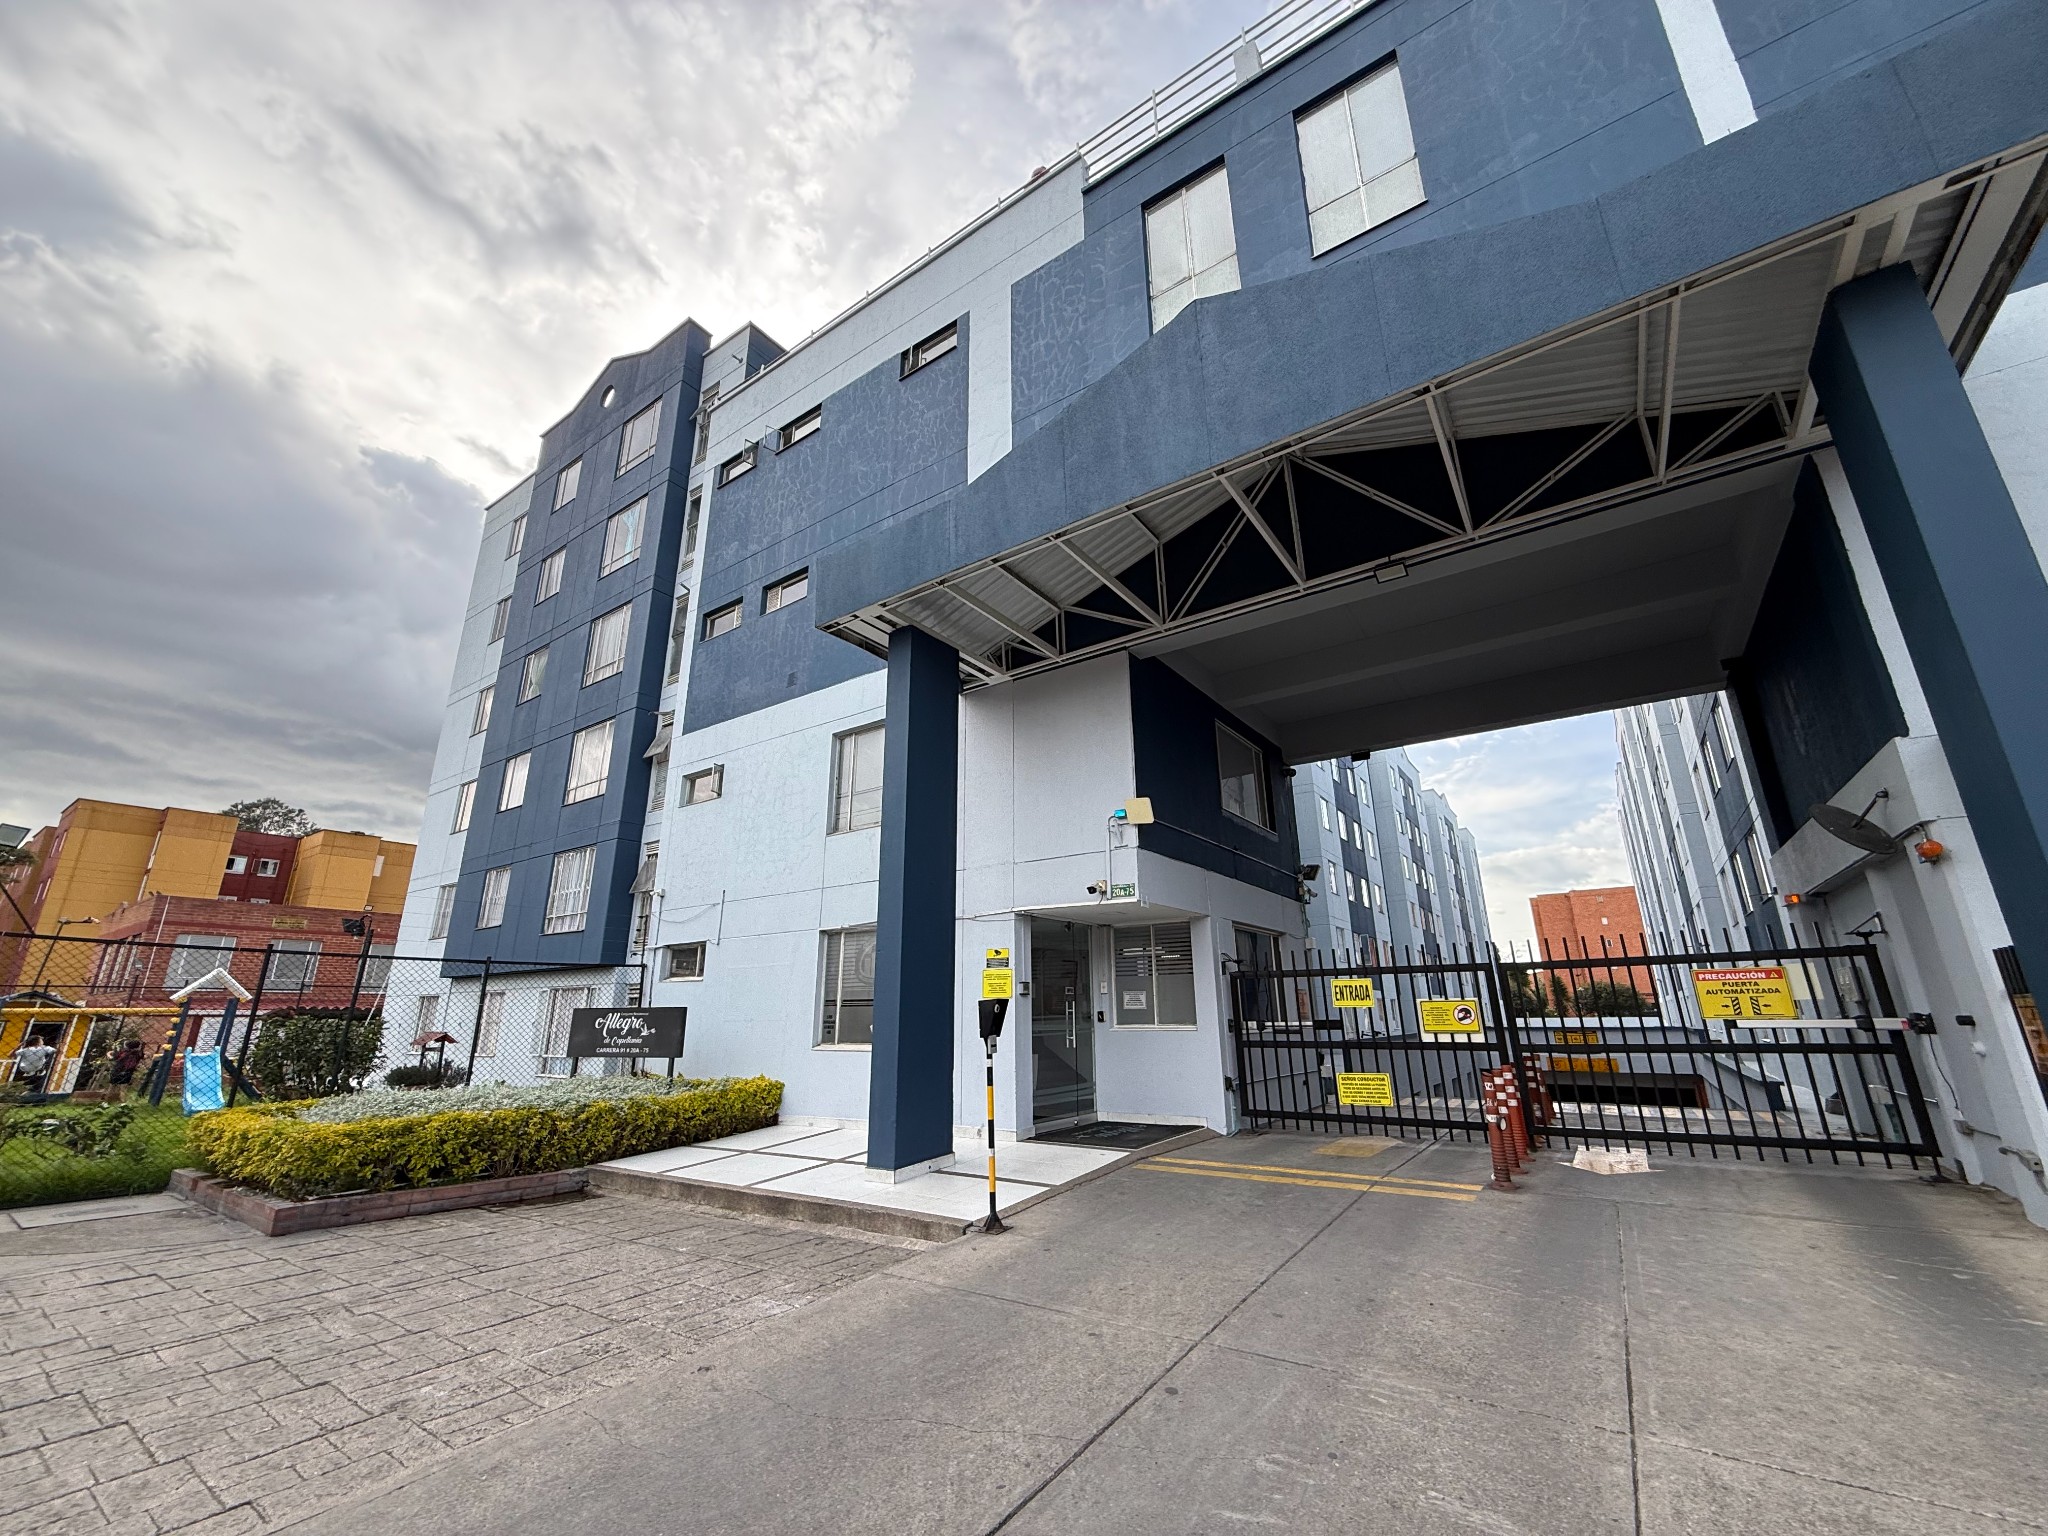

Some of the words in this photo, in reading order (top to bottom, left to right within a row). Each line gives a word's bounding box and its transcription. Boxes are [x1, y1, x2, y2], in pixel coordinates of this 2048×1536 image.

[1112, 887, 1134, 896] 20A-75
[1698, 971, 1766, 980] PRECAUCIÓN
[1334, 984, 1371, 1002] ENTRADA
[595, 1012, 645, 1037] Allegro
